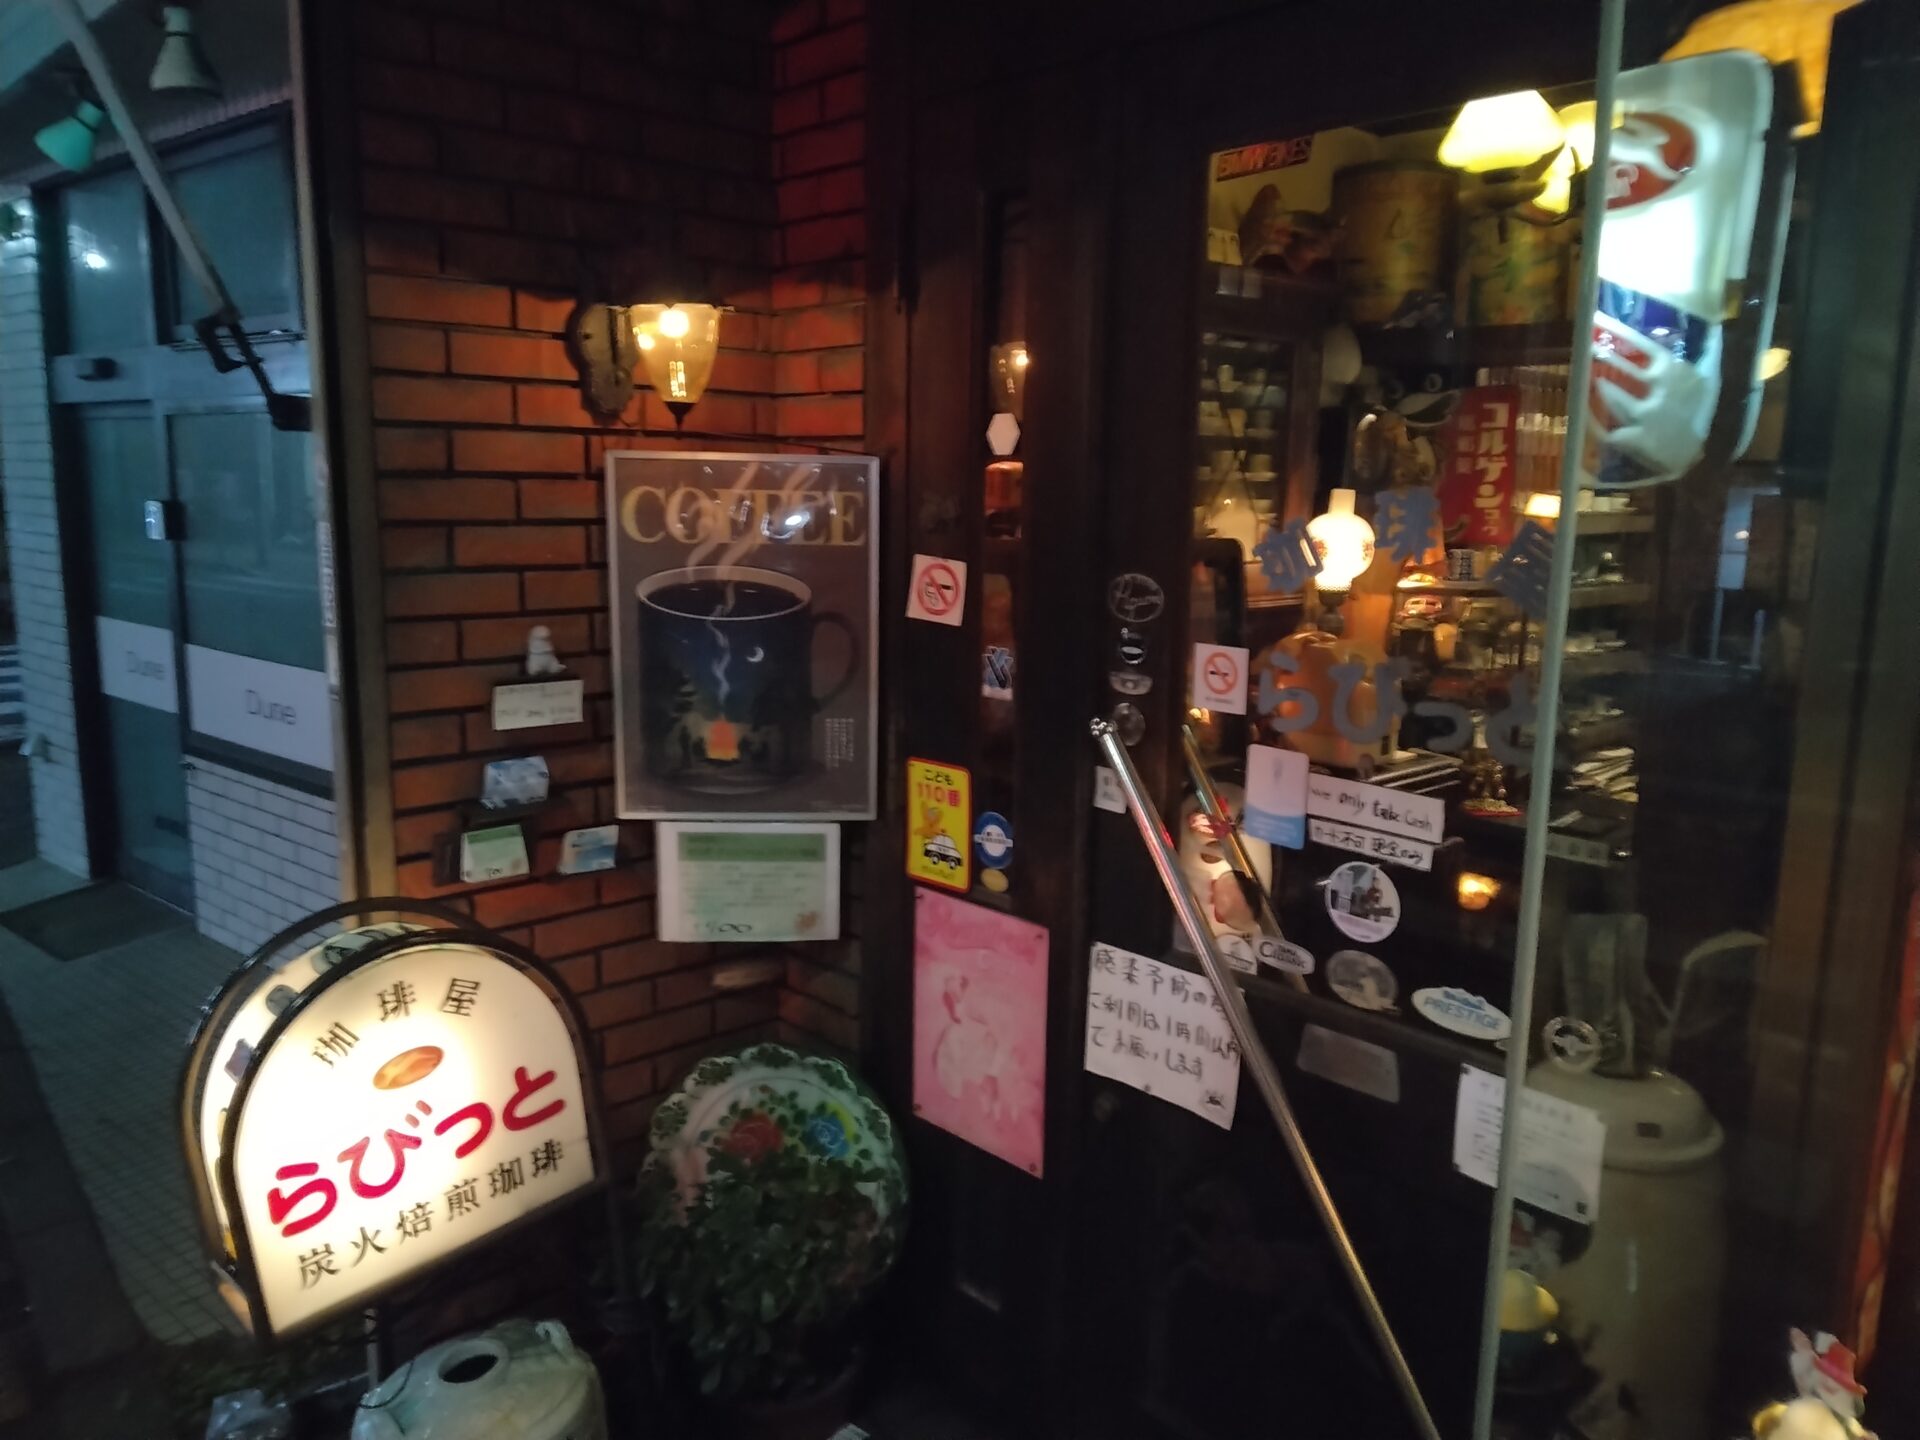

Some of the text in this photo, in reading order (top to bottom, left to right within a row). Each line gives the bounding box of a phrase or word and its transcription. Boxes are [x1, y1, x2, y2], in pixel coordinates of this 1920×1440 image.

[622, 485, 865, 546] COFFEE
[1257, 650, 1553, 766] らびっと
[924, 769, 954, 786] こども
[312, 976, 482, 1067] 珈琲屋
[266, 1065, 567, 1238] らびっと
[297, 1139, 566, 1290] 炭火焙煎珈琲
